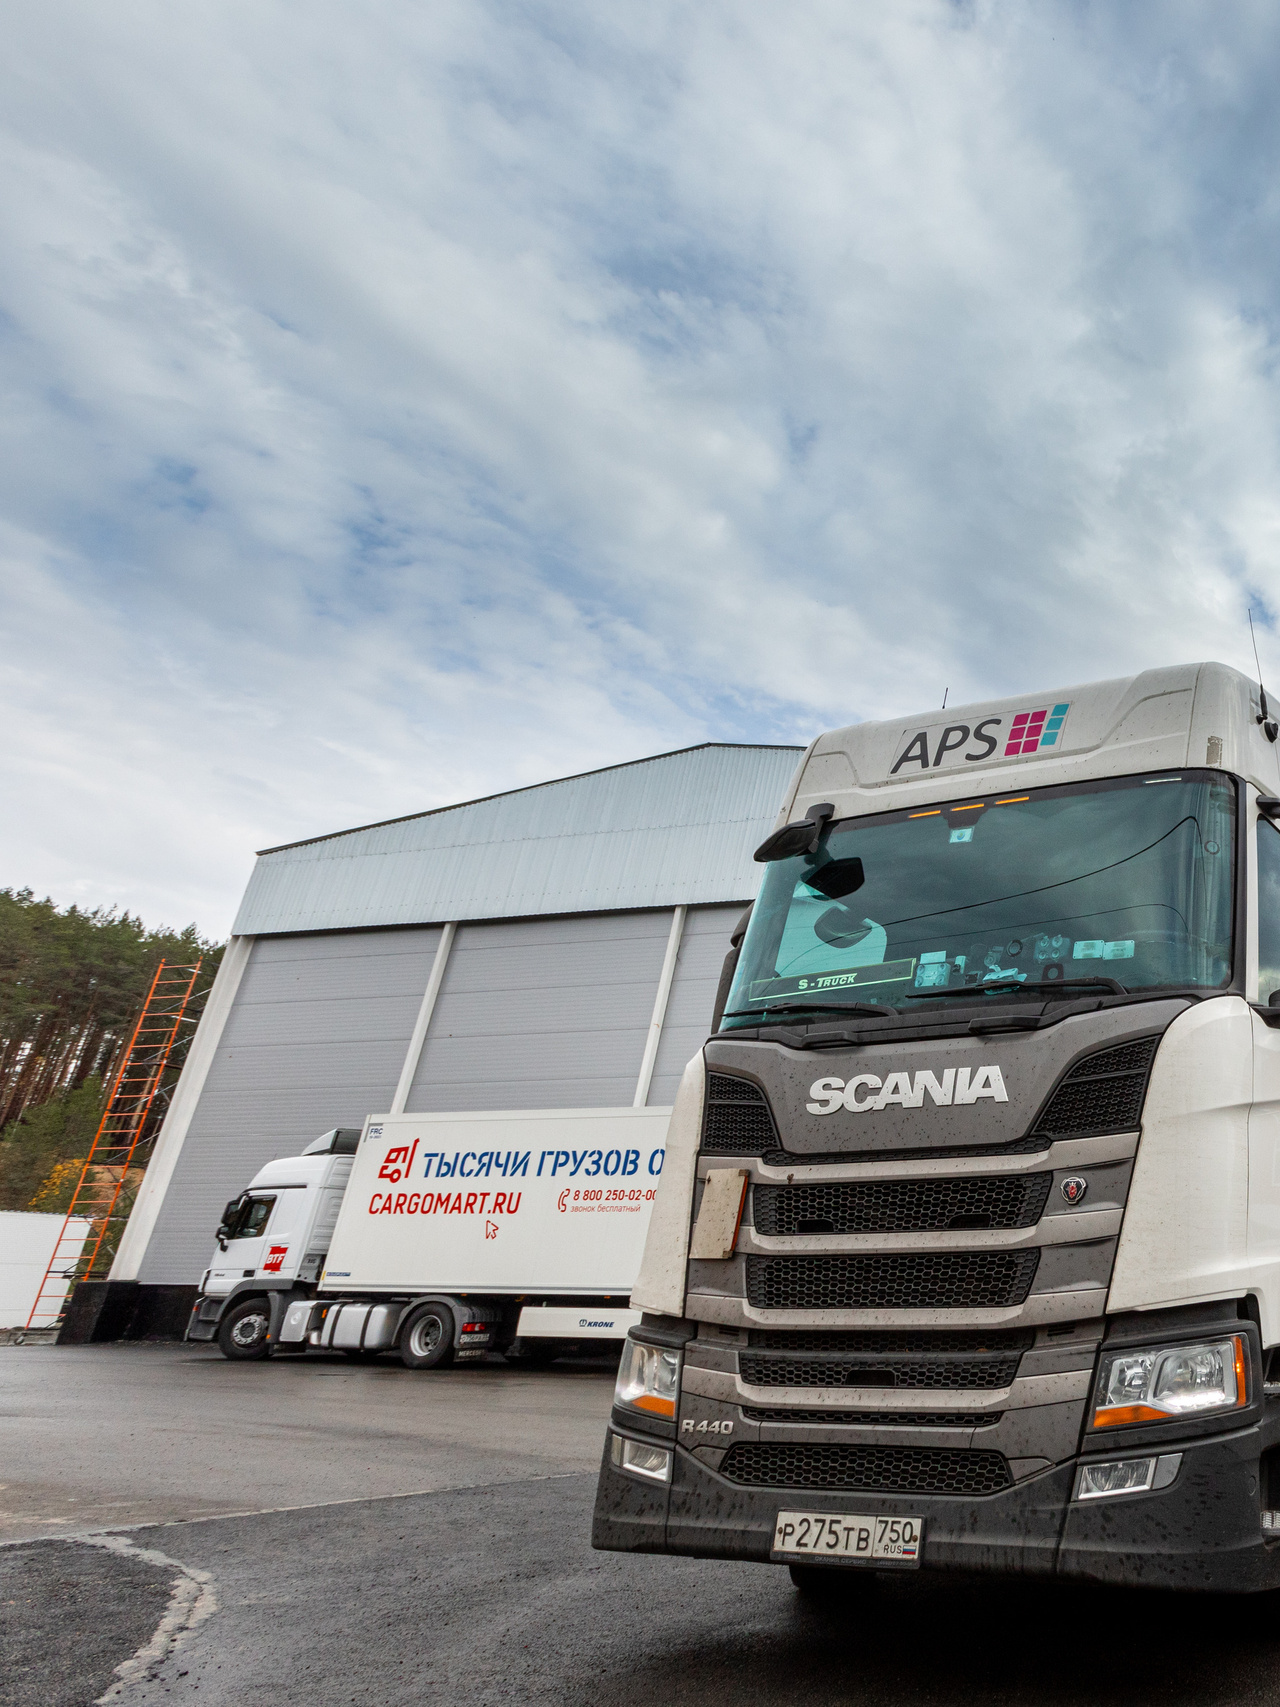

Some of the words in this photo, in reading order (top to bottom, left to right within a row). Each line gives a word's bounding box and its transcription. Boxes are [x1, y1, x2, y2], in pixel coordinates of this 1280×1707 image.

[890, 718, 1002, 775] APS
[806, 1065, 1009, 1116] SCANIA
[424, 1151, 531, 1178] ТЫСЯЧИ
[536, 1149, 640, 1177] ГРУЗОВ
[368, 1192, 522, 1215] CARGOMART.RU
[573, 1189, 581, 1201] 8
[582, 1189, 603, 1201] 800
[570, 1205, 595, 1213] звонок
[597, 1204, 641, 1213] бесплатный
[266, 1254, 285, 1264] BTF
[883, 1544, 902, 1554] RUS
